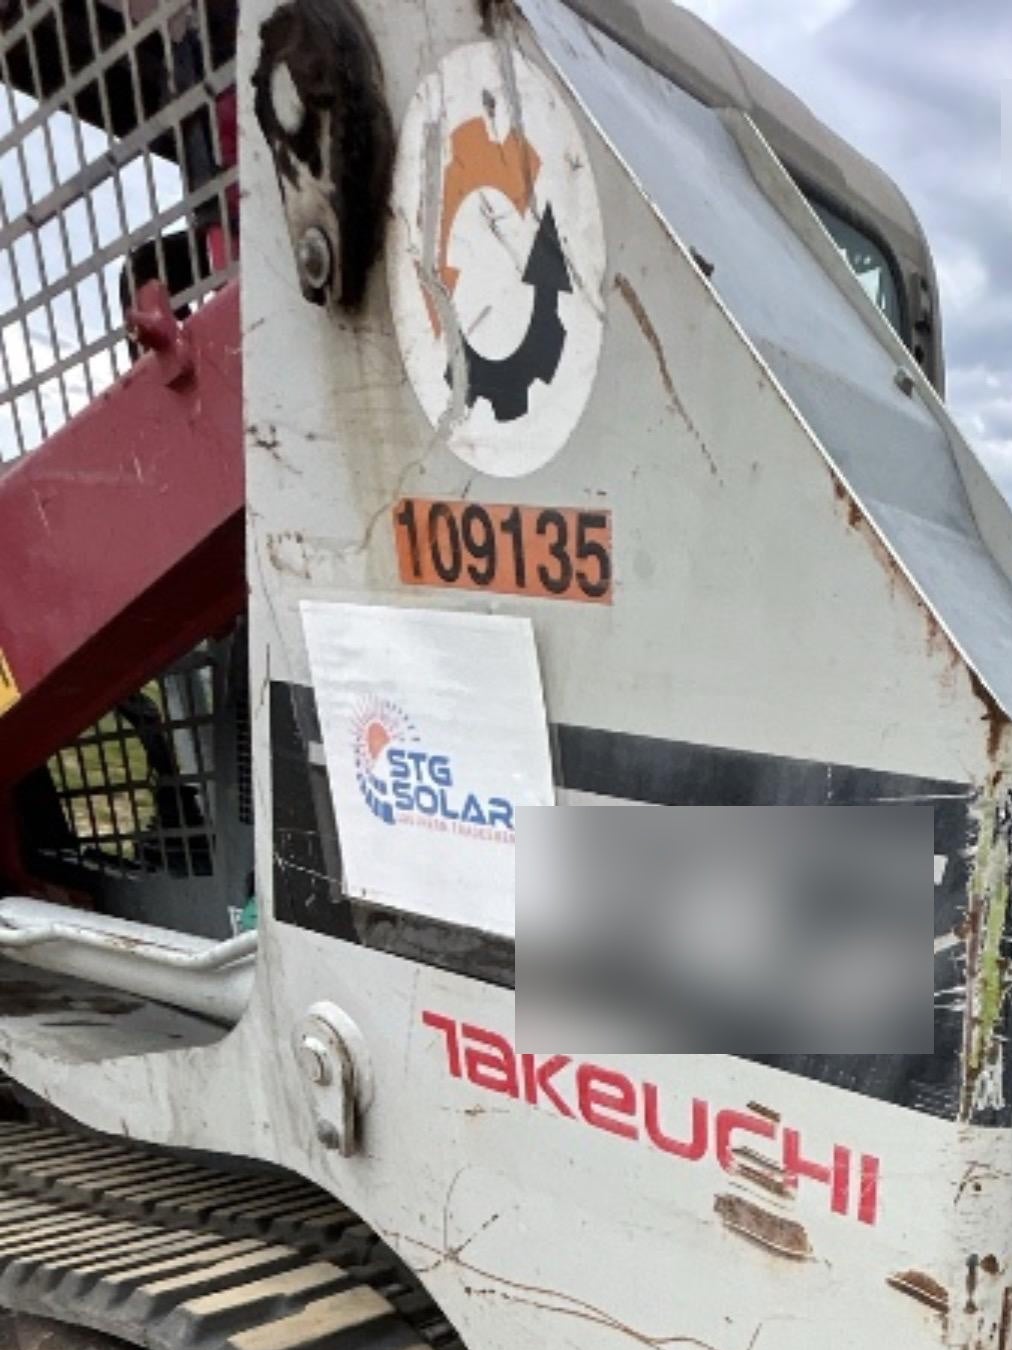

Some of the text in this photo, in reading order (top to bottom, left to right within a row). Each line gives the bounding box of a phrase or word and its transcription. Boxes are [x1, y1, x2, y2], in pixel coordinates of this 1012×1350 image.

[398, 499, 613, 598] 109135
[386, 750, 453, 787] STG
[392, 780, 515, 829] SOLAR
